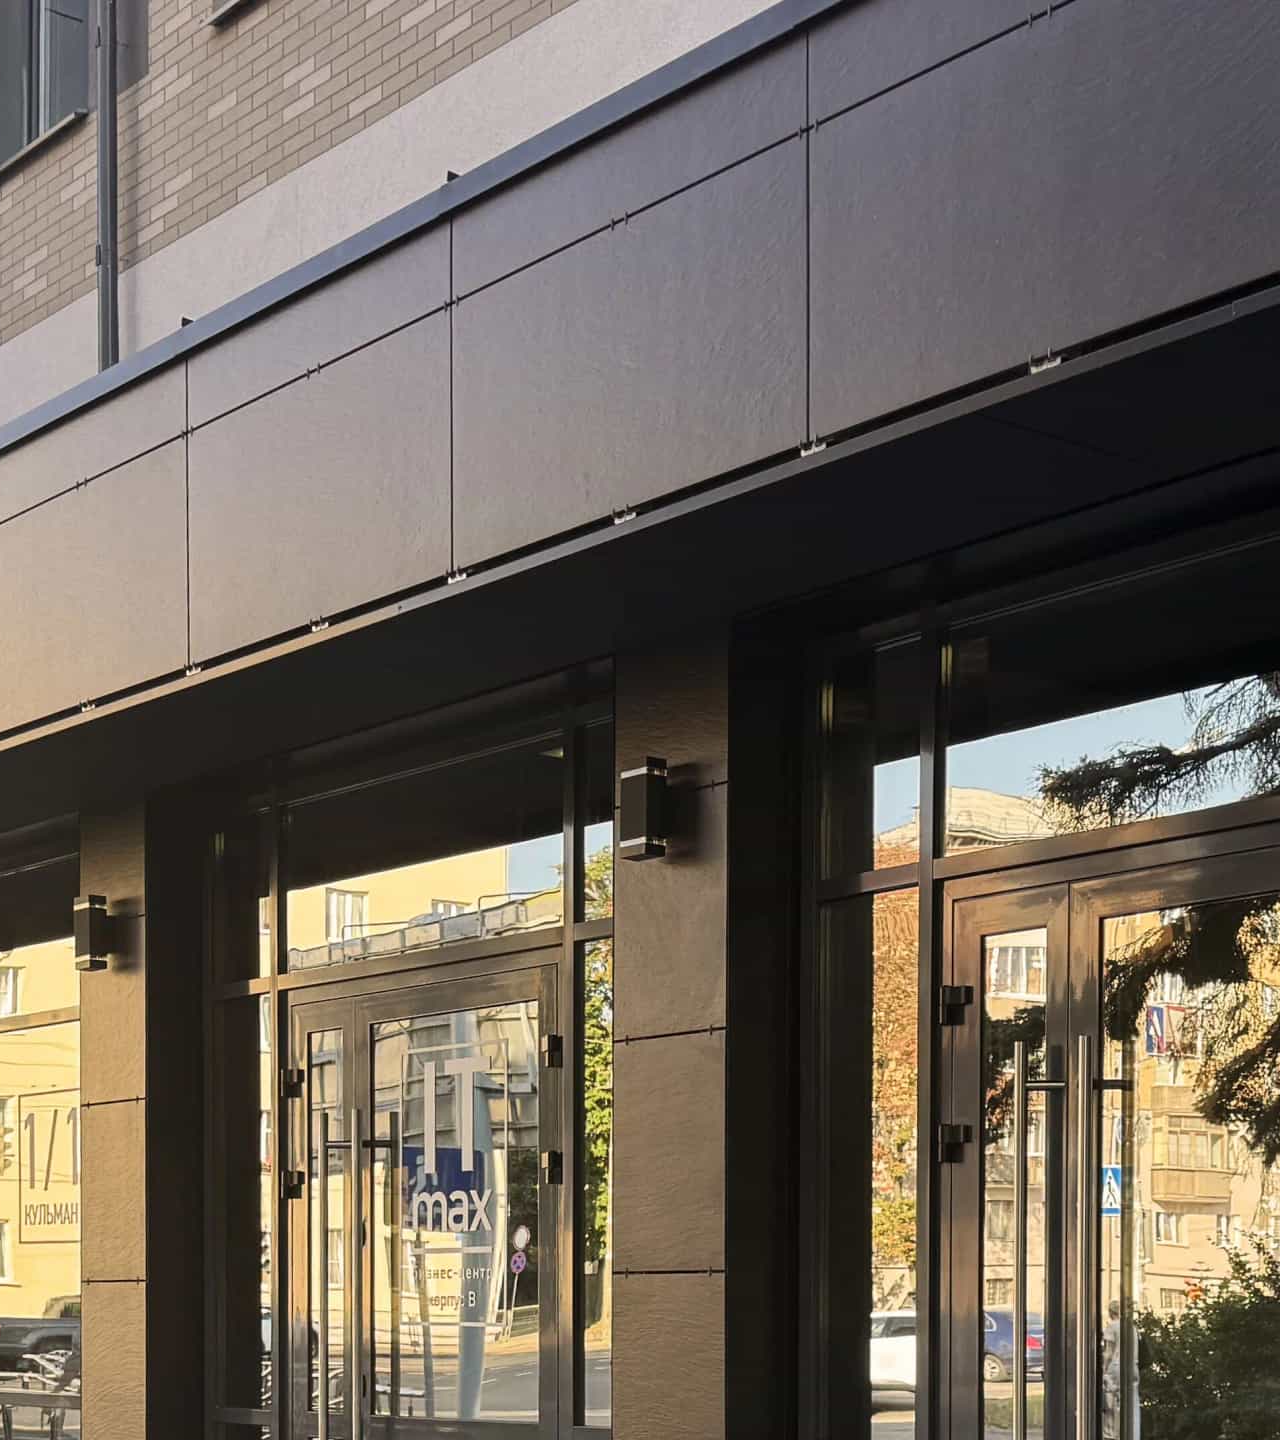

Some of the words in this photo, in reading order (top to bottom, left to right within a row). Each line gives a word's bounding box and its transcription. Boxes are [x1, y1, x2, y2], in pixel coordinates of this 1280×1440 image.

[423, 1056, 492, 1174] IT
[23, 1106, 80, 1191] 1/1
[24, 1203, 79, 1226] КУЛЬМАН
[412, 1188, 492, 1232] max
